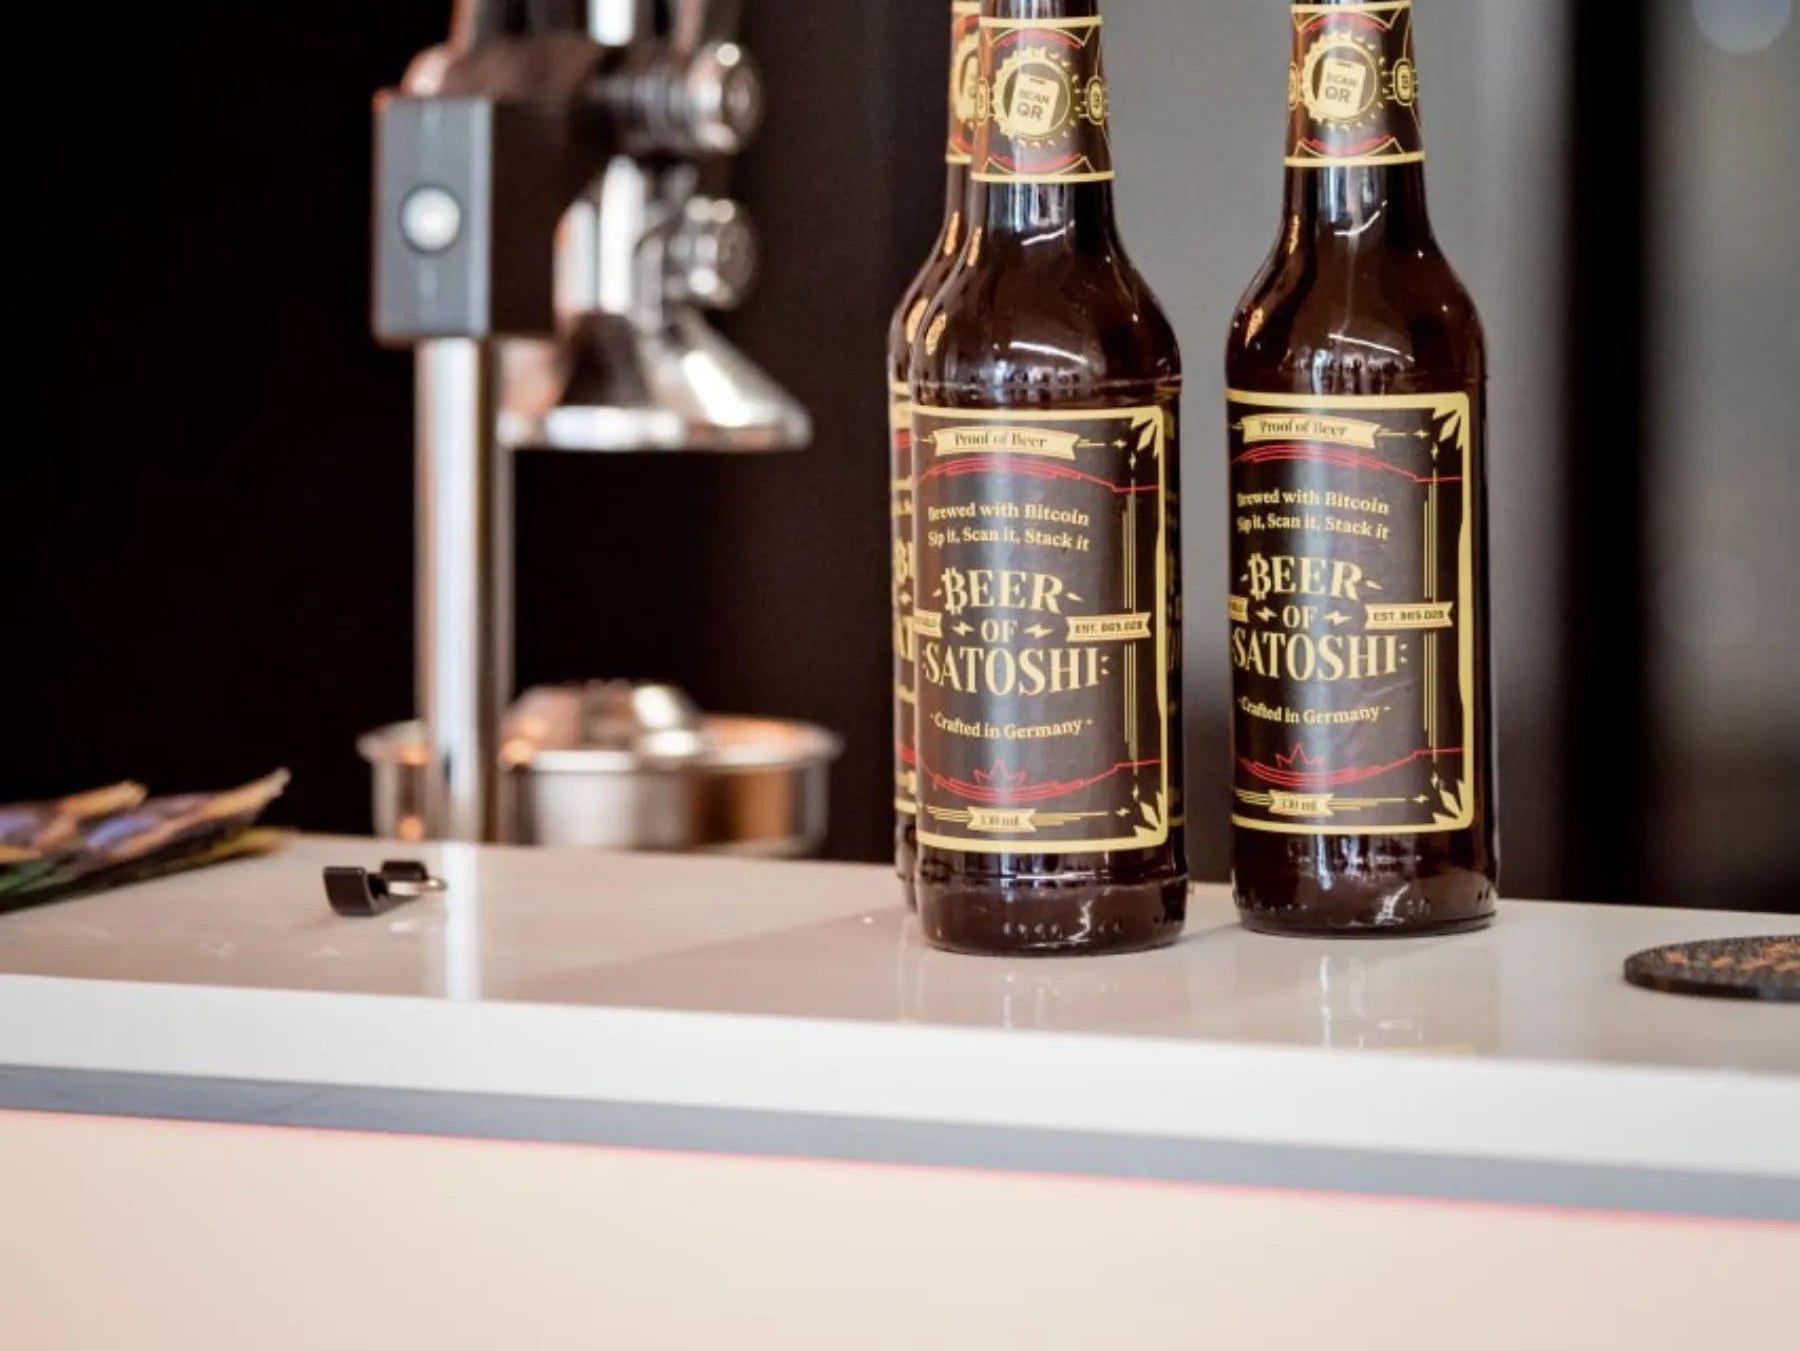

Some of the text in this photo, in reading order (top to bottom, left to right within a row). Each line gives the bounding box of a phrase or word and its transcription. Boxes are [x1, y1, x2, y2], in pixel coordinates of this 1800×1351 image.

[1324, 86, 1351, 105] QR
[1016, 102, 1043, 121] QR
[1260, 418, 1348, 436] Proof of Beer
[954, 432, 1047, 448] Proof of Beer
[928, 502, 975, 521] Brewed
[979, 501, 1018, 518] with
[1024, 503, 1089, 526] Bitcoin
[1283, 488, 1319, 505] with
[1325, 491, 1389, 515] Bitcoin
[962, 525, 999, 542] Scan
[1024, 527, 1072, 548] Stack
[1076, 534, 1090, 551] it
[1267, 513, 1301, 530] Scan
[1325, 516, 1373, 537] Stack
[1376, 522, 1389, 540] it
[1282, 605, 1318, 629] OF
[980, 618, 1018, 643] OF
[1232, 626, 1397, 681] SATOSHI
[925, 640, 1100, 696] SATOSHI
[1241, 696, 1380, 726] Crafted in Germany
[933, 711, 1082, 740] Crafted in Germany
